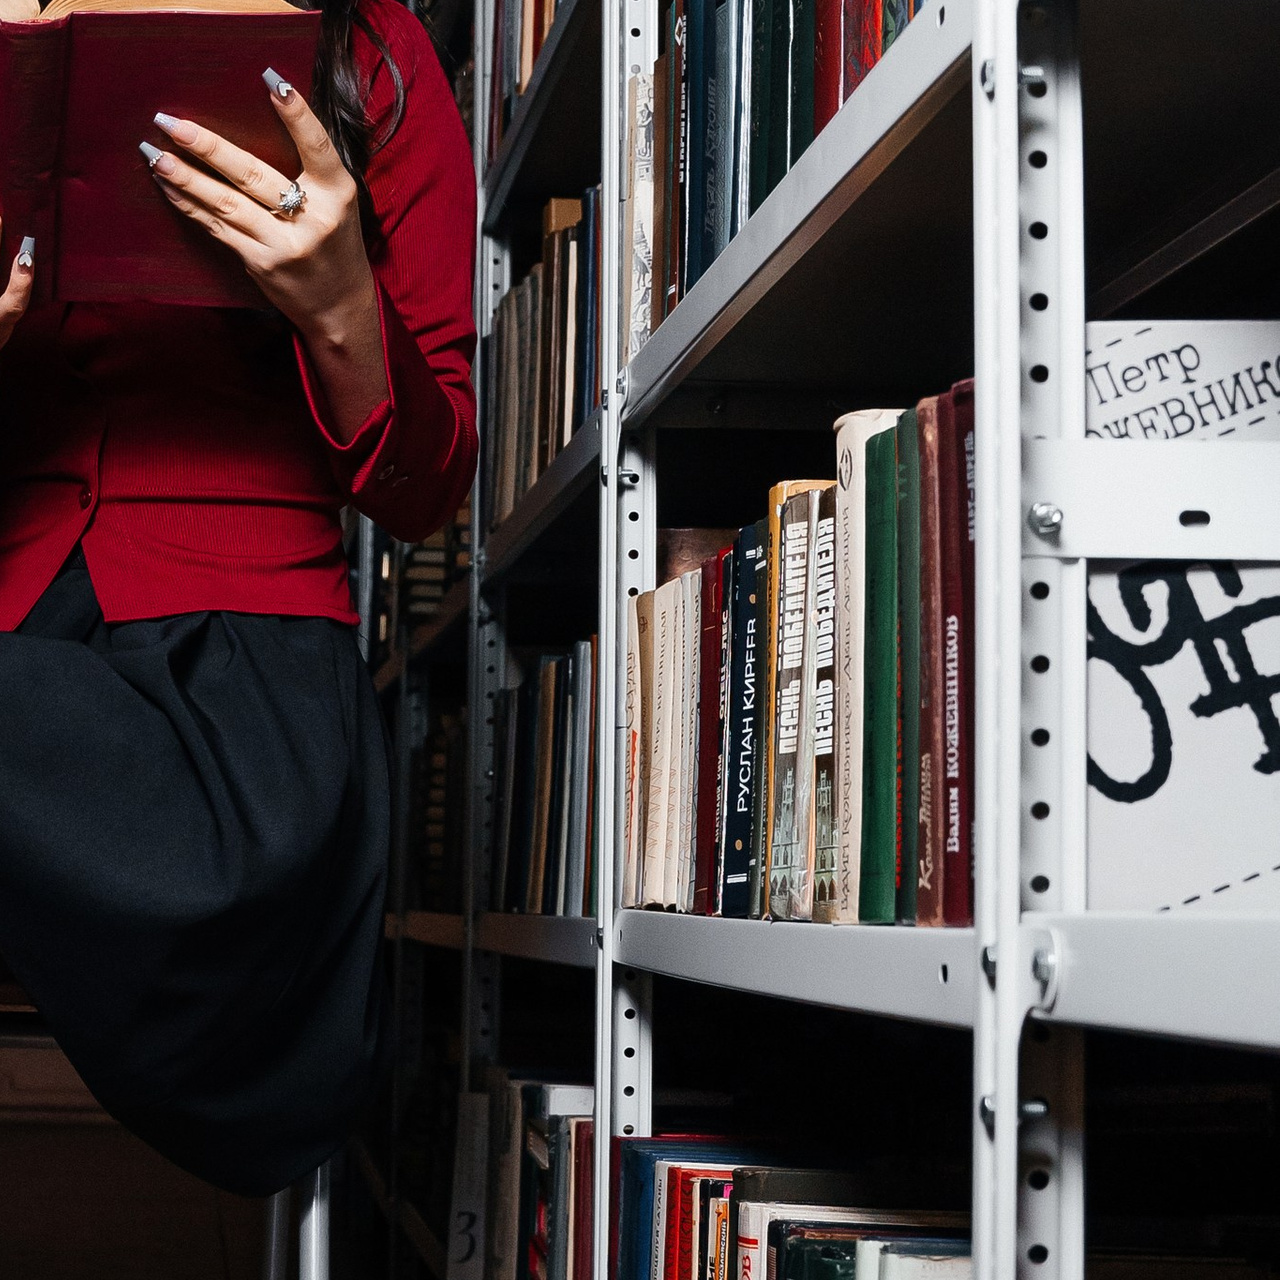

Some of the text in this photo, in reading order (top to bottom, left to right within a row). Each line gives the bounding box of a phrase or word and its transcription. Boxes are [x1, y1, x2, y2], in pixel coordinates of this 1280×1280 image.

[1086, 343, 1201, 406] Петр
[657, 611, 666, 710] КЕТЛИНСКАЯ
[779, 521, 808, 754] ПЕСНЬ ПОБЕДИТЕЛЯ
[815, 518, 835, 756] ПЕСНЬ ПОБЕДИТЕЛЯ
[736, 717, 754, 812] РУСЛАН
[842, 694, 852, 836] КОЖЕВНИКОВ
[945, 616, 960, 853] Вадим КОЖЕВНИКОВ
[457, 1211, 477, 1263] 3
